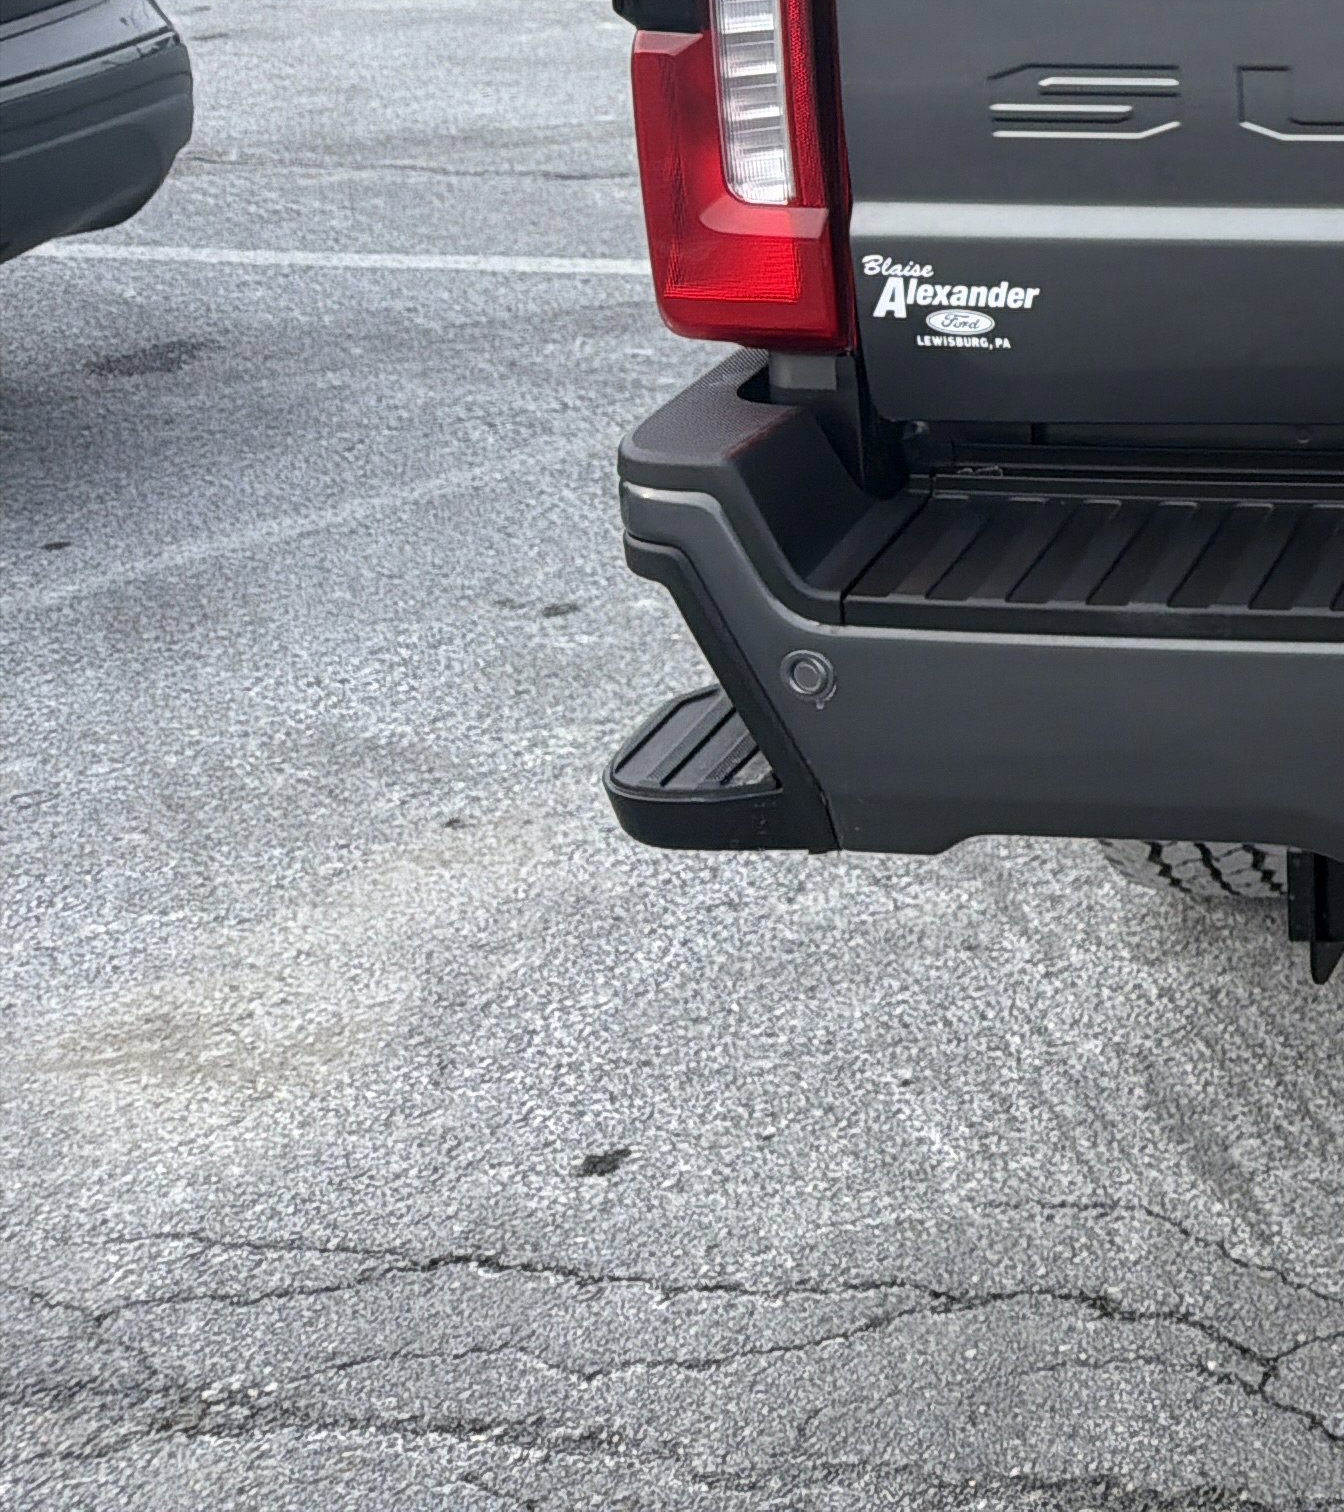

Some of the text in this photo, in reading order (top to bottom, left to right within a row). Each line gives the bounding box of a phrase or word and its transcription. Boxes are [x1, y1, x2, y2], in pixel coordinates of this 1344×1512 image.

[861, 254, 934, 278] Blaise
[873, 276, 1040, 318] Alexander
[940, 313, 981, 330] Ford
[916, 335, 1012, 350] LEWISBURG, PA
